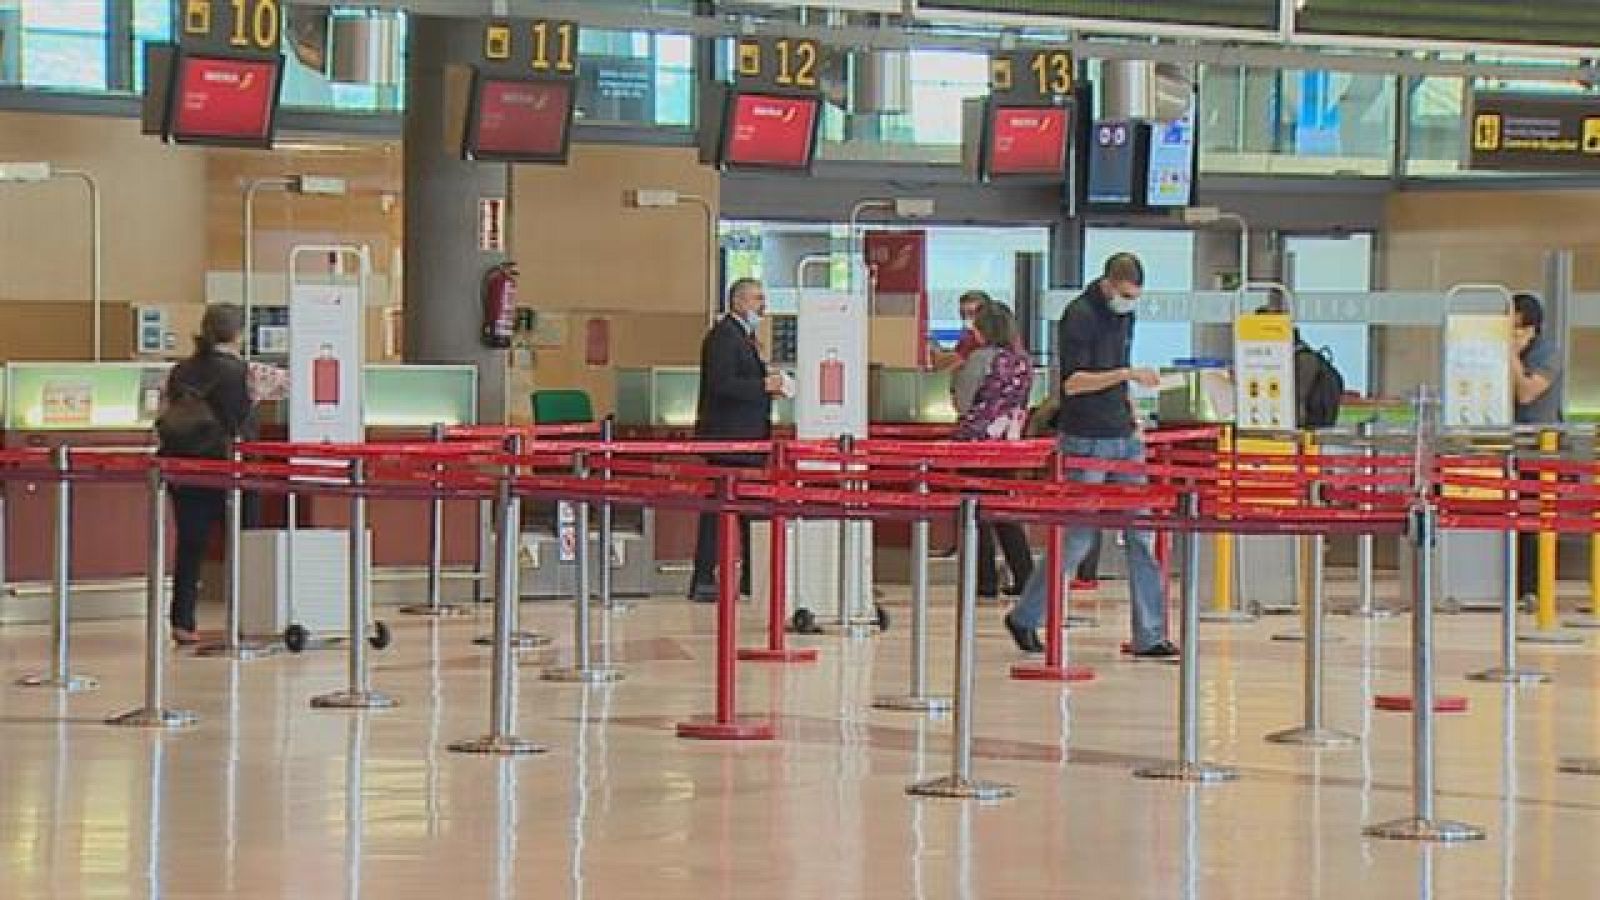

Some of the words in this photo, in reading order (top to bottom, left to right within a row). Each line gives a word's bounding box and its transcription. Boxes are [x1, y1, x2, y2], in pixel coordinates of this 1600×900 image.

[229, 0, 277, 46] 10
[531, 22, 574, 70] 11
[775, 40, 816, 86] 12
[1031, 53, 1072, 94] 13
